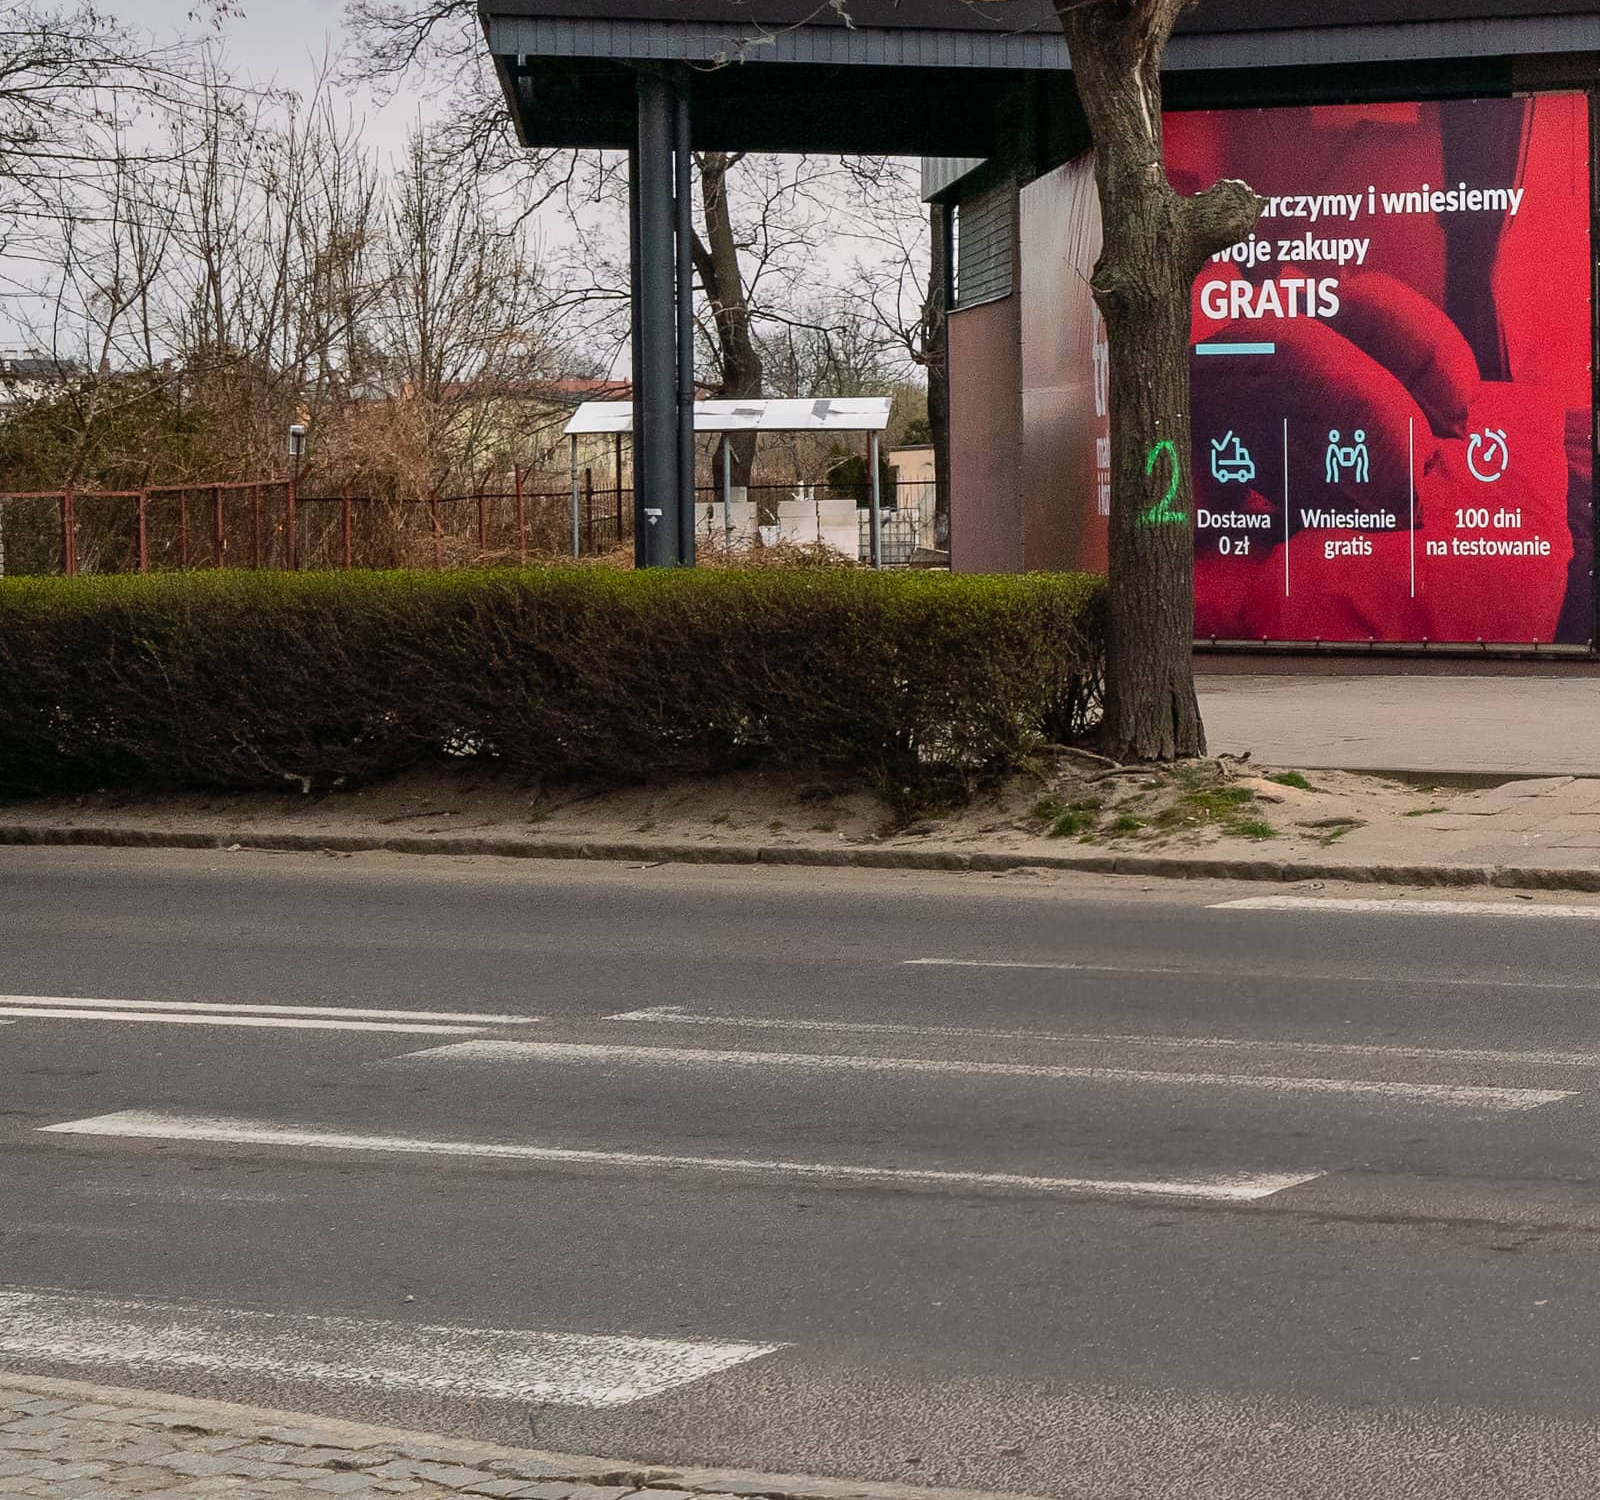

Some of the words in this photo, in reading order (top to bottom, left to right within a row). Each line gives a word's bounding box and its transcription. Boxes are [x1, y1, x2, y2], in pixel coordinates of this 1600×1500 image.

[1260, 194, 1362, 222] rczymy
[1368, 185, 1376, 215] i
[1382, 182, 1524, 214] wniesiemy
[1210, 233, 1271, 268] woje
[1277, 232, 1370, 265] zakupy
[1201, 277, 1340, 318] GRATIS
[1136, 438, 1188, 527] 2
[1197, 509, 1271, 529] Dostawa
[1301, 509, 1396, 528] Wniesienie
[1454, 508, 1487, 527] 100
[1492, 508, 1521, 528] dni
[1219, 537, 1231, 555] 0
[1234, 536, 1250, 555] zł
[1324, 537, 1372, 558] gratis
[1427, 541, 1449, 555] na
[1453, 537, 1550, 555] testowanie
